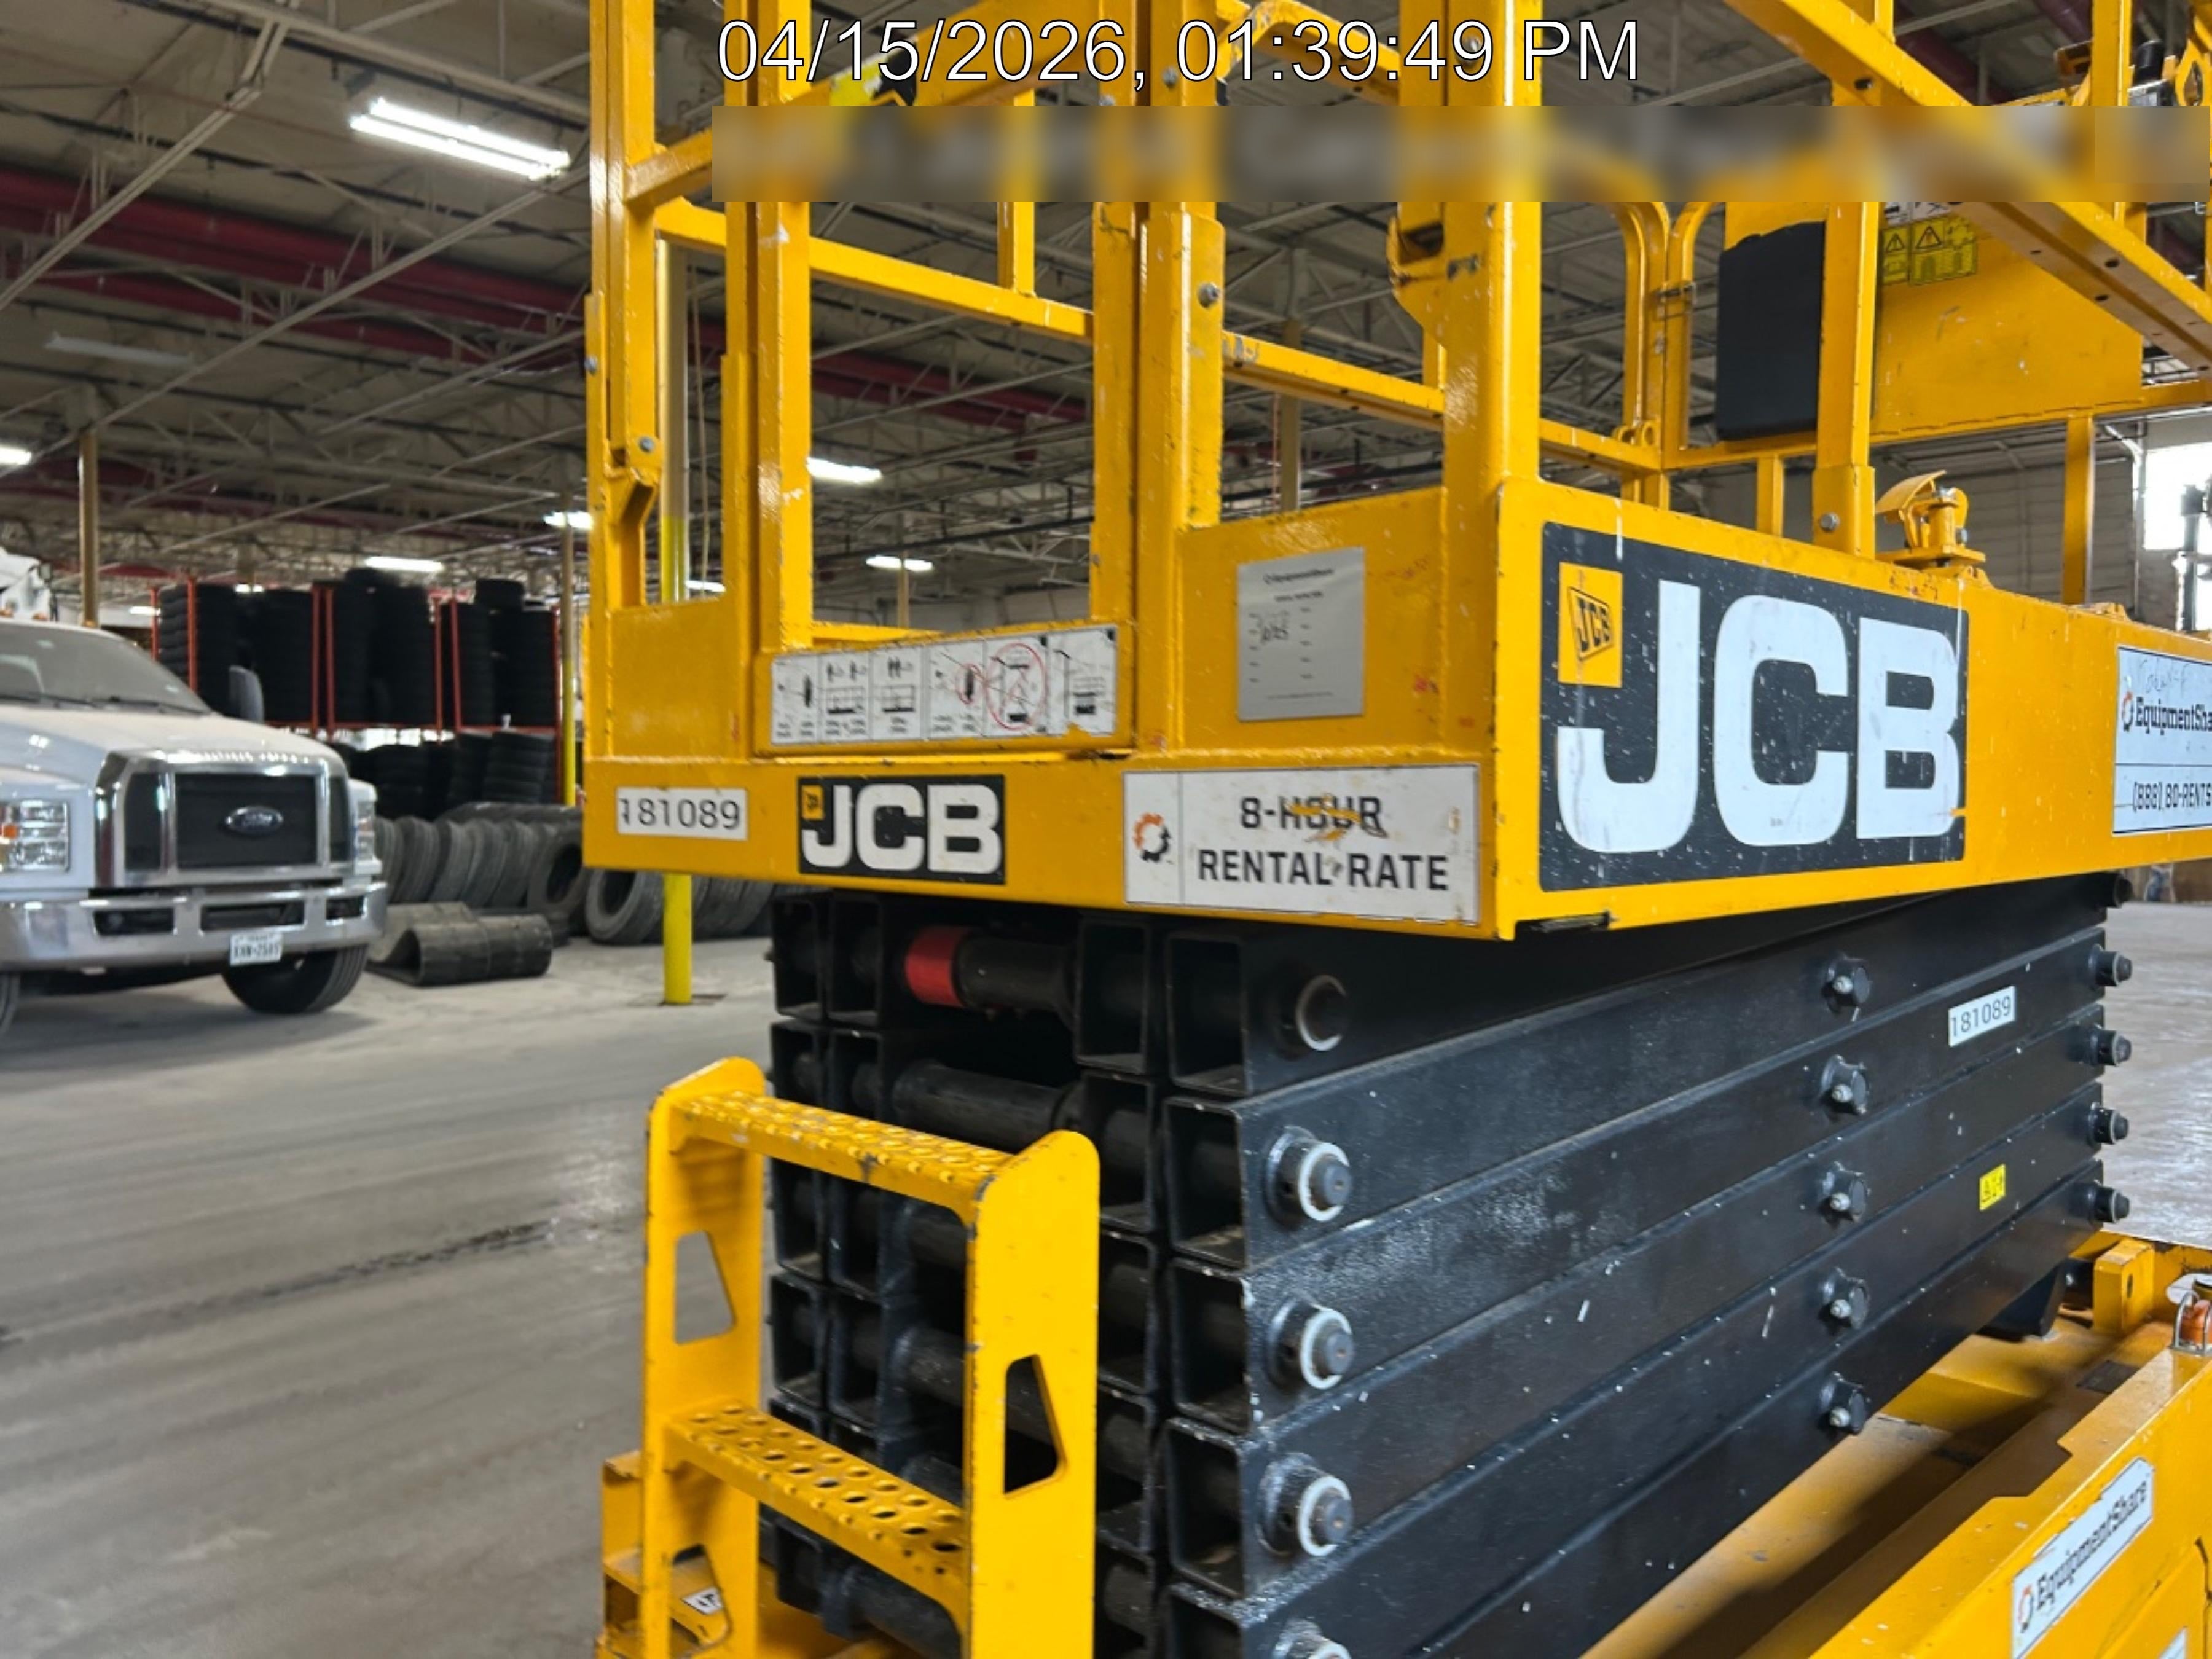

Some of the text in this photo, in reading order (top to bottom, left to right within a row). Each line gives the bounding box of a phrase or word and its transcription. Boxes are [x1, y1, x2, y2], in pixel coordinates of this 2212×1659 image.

[1557, 579, 1960, 853] JCB
[619, 798, 740, 830] 181089
[801, 784, 1002, 874] JCB
[1240, 796, 1384, 831] 8-HOUR
[1199, 848, 1449, 891] RENTAL RATE
[1950, 995, 2012, 1038] 181089
